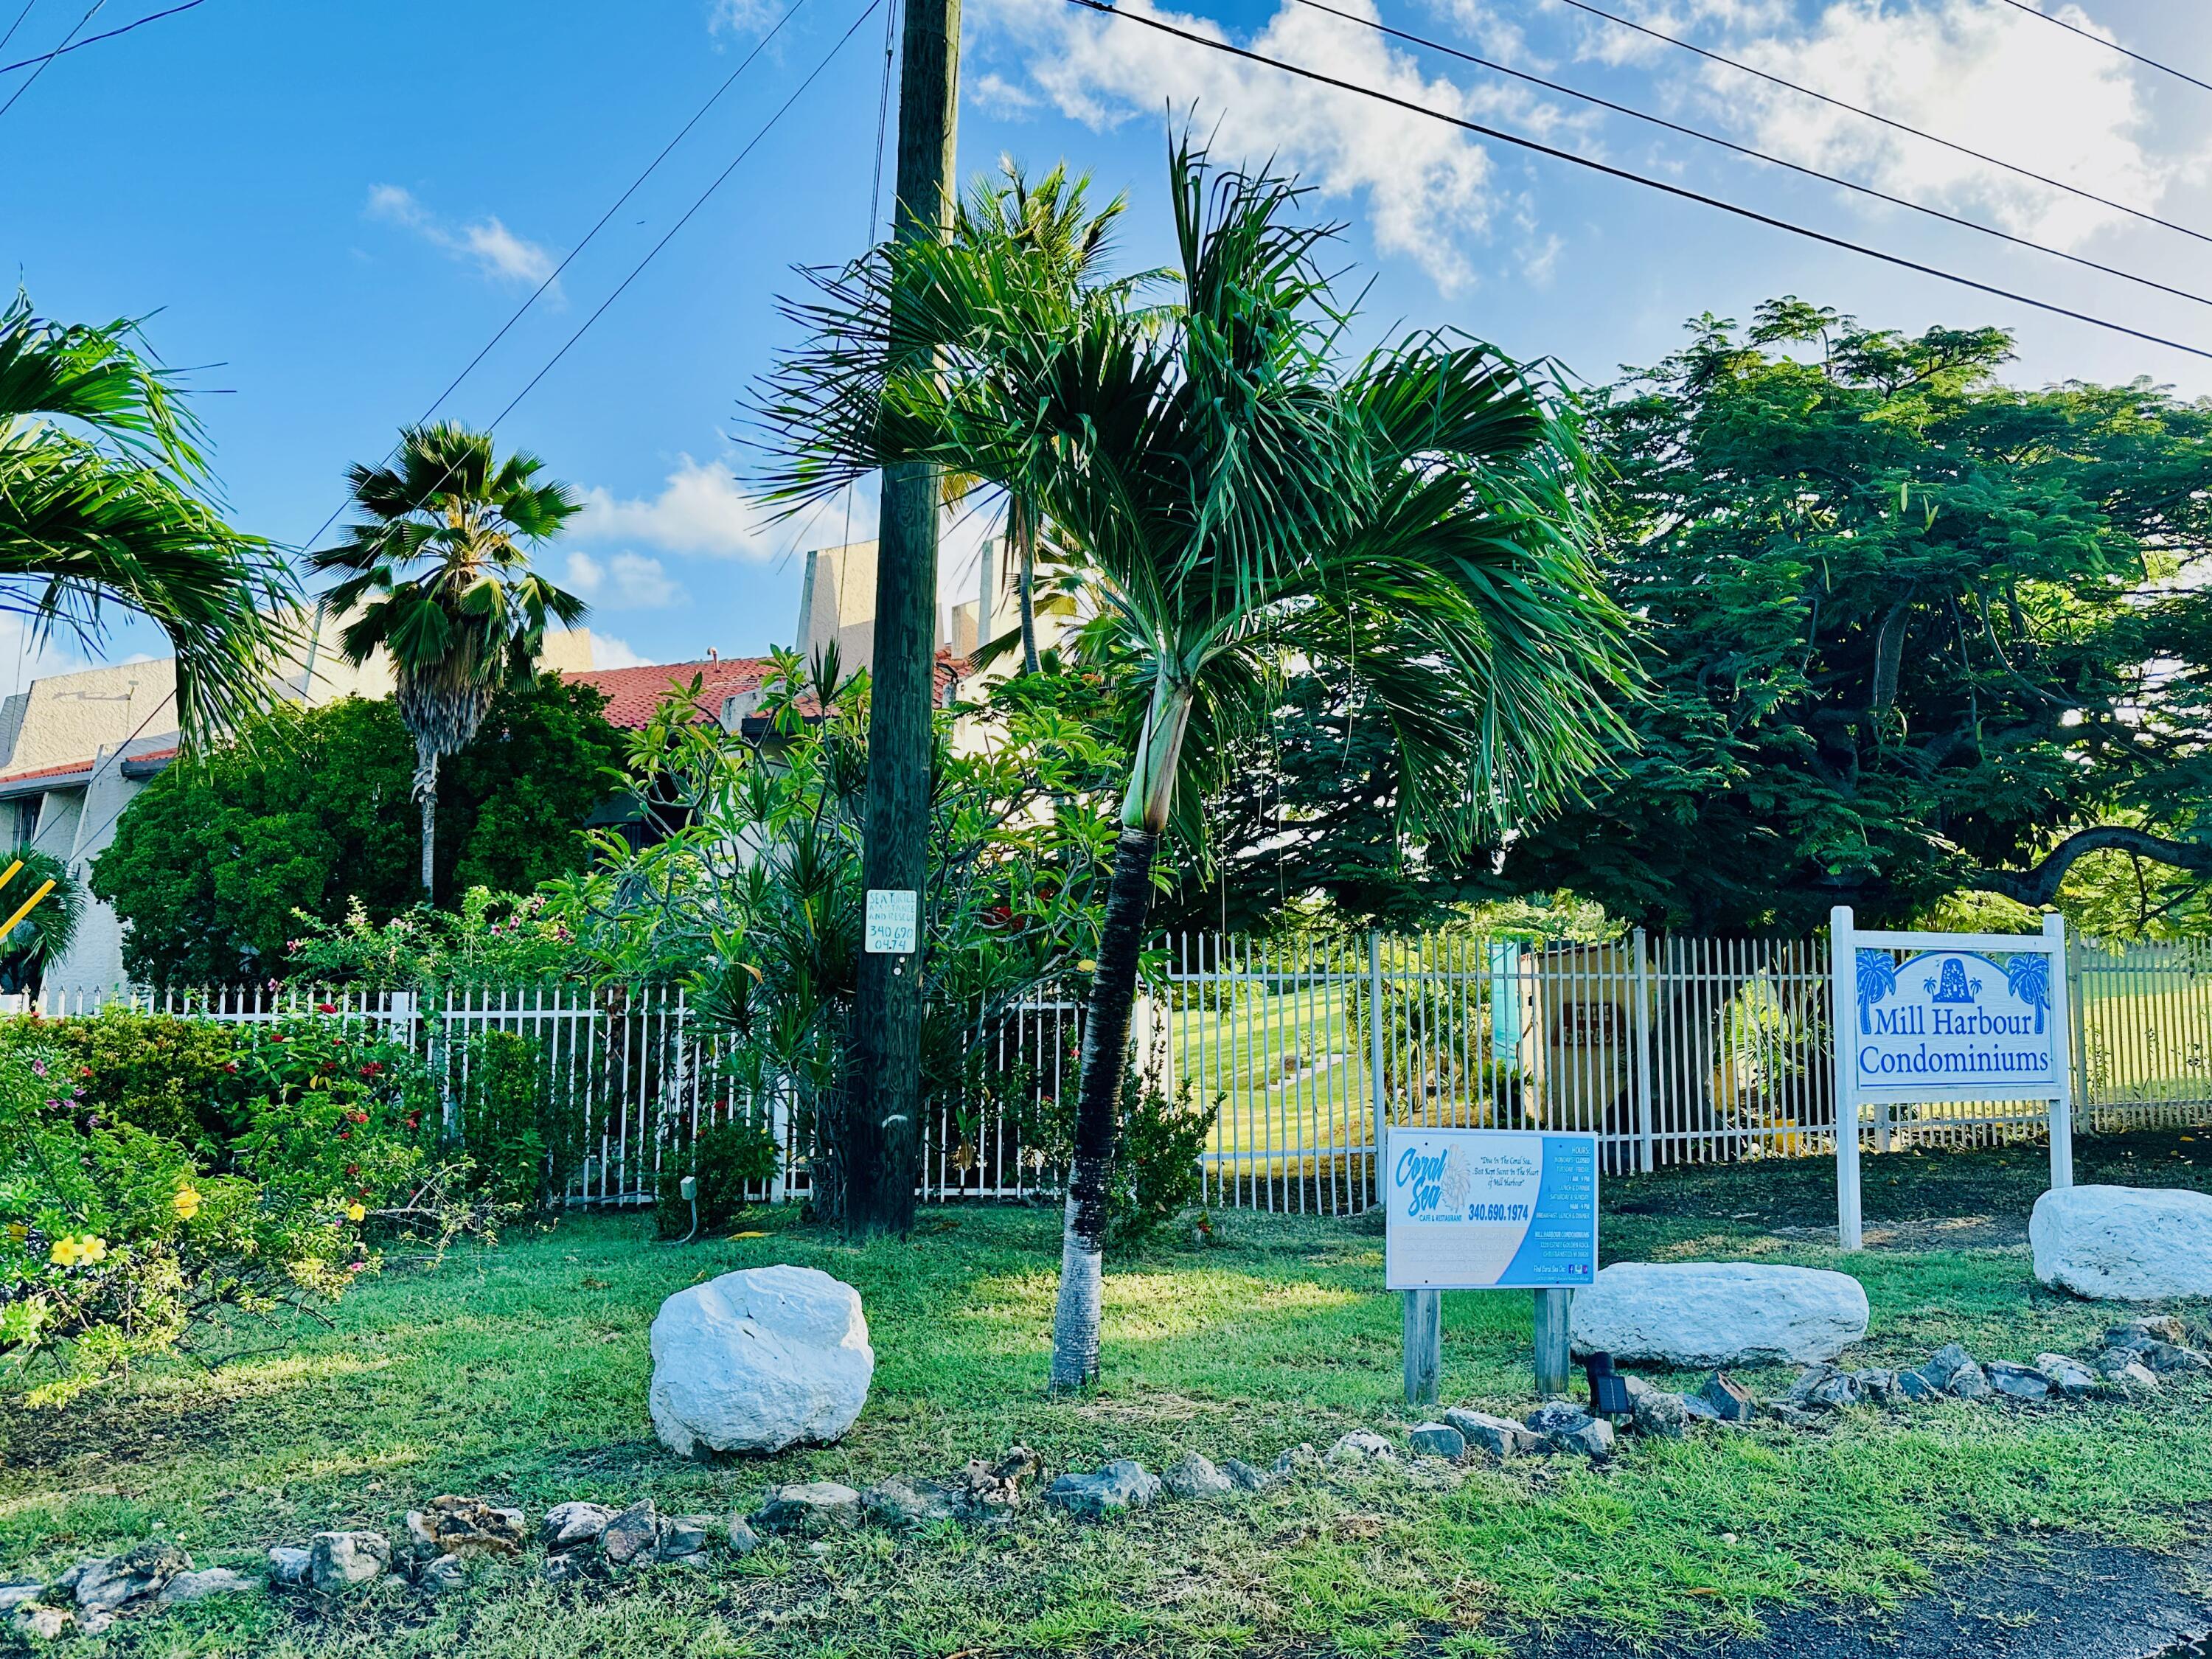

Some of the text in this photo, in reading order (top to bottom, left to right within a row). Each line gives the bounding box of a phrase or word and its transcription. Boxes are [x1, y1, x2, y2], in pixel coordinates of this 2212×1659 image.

[869, 892, 915, 904] SEA TURTLE
[888, 913, 915, 922] RESCUE
[870, 925, 914, 939] 340 690
[875, 939, 906, 950] 0474
[1874, 1005, 2032, 1036] Mill Harbour
[1860, 1043, 2048, 1074] Condominiums
[1395, 1147, 1447, 1187] Coral
[1408, 1176, 1443, 1217] Sea
[1468, 1203, 1528, 1221] 340.690.1974
